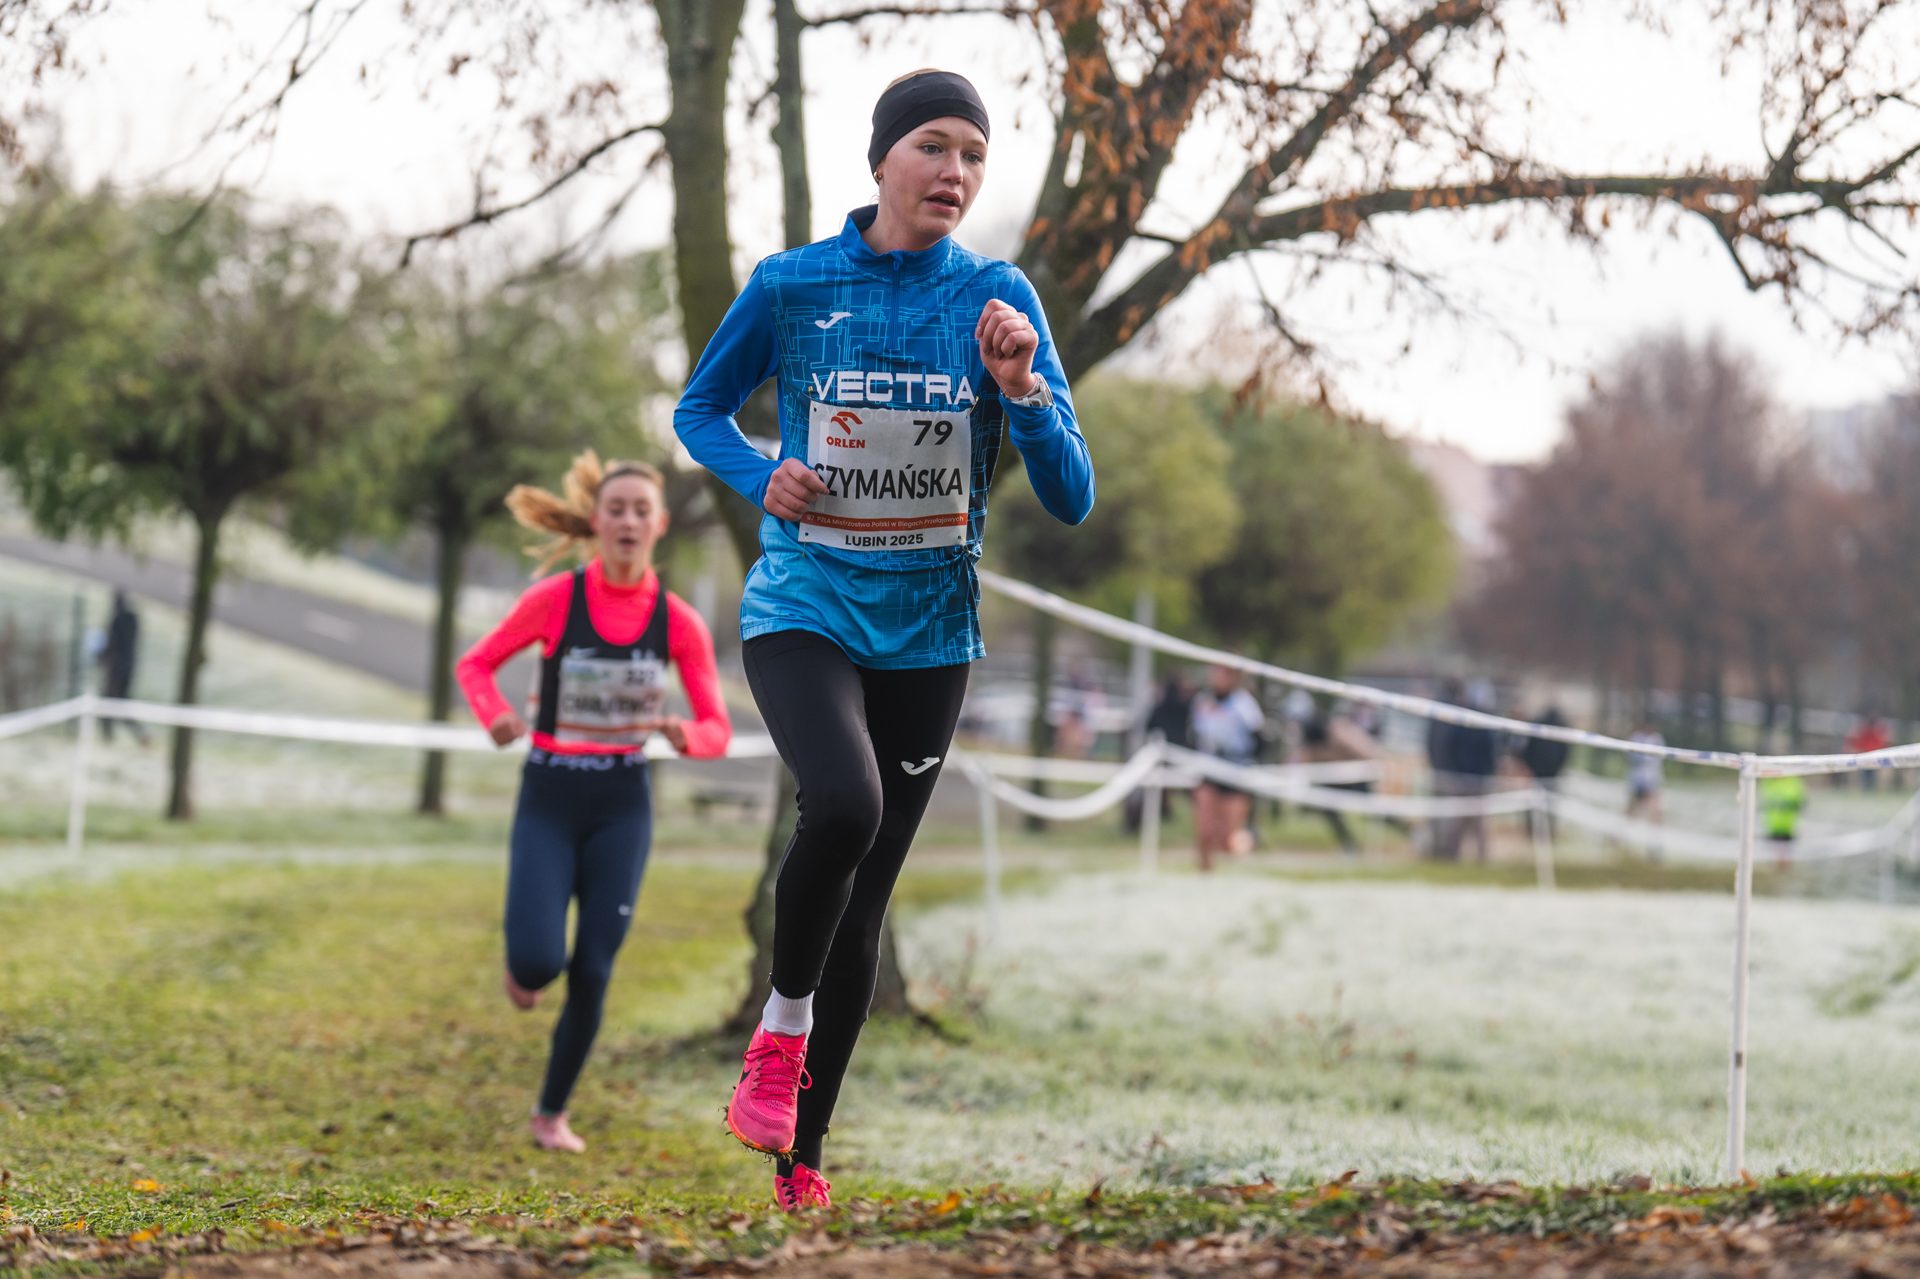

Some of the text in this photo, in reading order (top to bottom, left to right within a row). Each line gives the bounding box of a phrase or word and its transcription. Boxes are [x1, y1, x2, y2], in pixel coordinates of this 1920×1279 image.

[811, 371, 976, 405] VECTRA
[826, 436, 866, 449] ORLEN
[913, 420, 953, 447] 79
[814, 462, 963, 500] SZYMAŃSKA
[832, 518, 871, 528] Mistrzostwa
[871, 520, 890, 528] Polski
[897, 519, 923, 529] Biegach
[845, 533, 924, 547] LUBIN 2025
